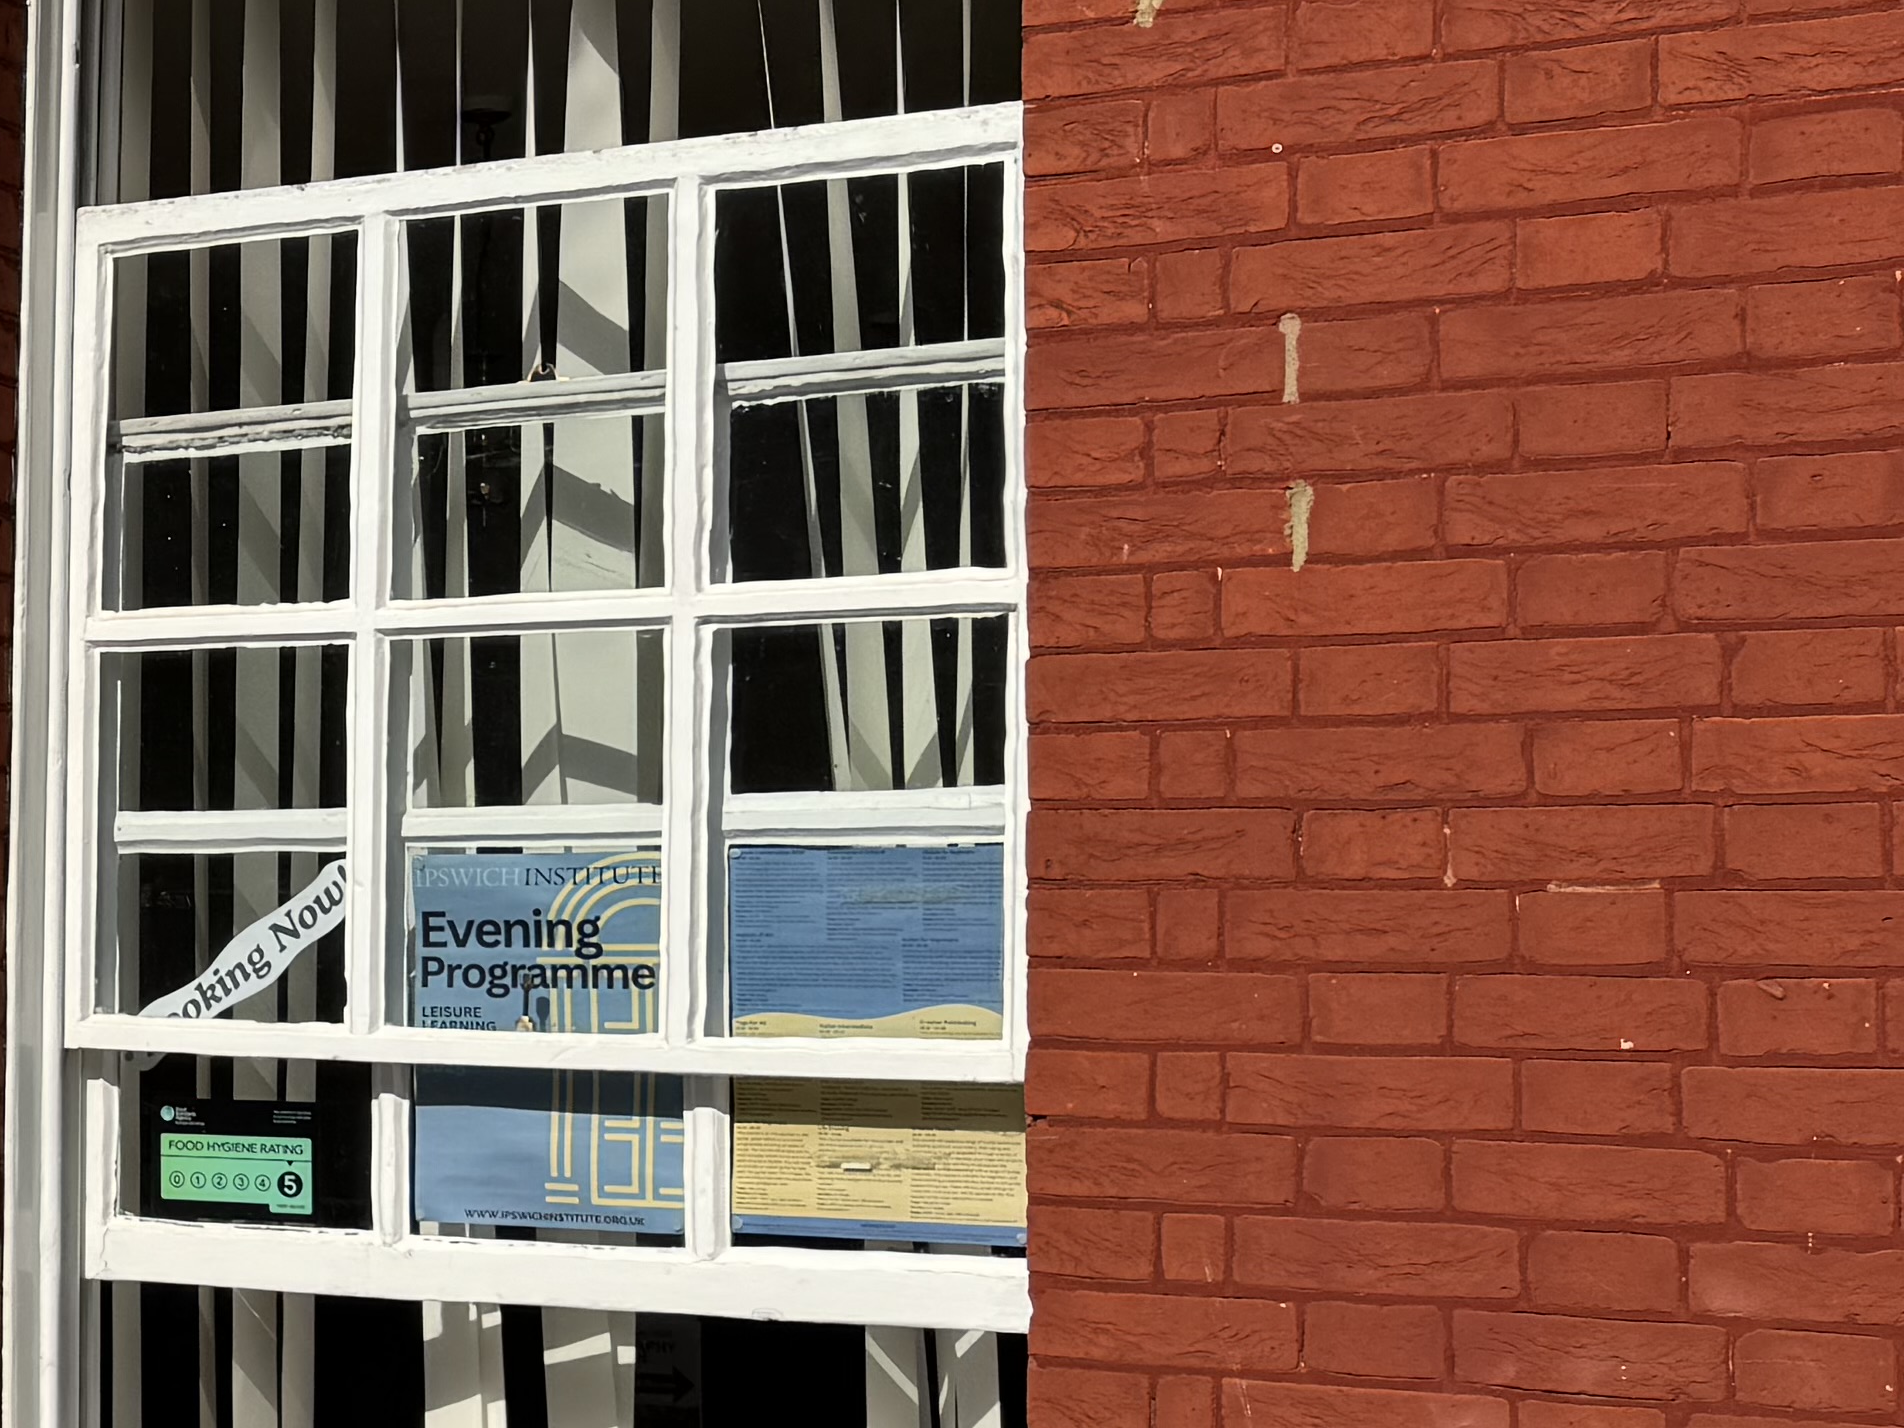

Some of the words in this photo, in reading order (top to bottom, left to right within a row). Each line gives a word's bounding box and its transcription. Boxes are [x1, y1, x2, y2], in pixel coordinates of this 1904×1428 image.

[415, 867, 521, 888] IPSWICH
[421, 908, 604, 960] Evening
[421, 956, 657, 999] Programme
[422, 1006, 482, 1019] LEISURE
[422, 1020, 497, 1031] LEARNING
[168, 1140, 204, 1152] FOOD
[207, 1141, 257, 1154] HYGIENE
[260, 1143, 304, 1155] RATING
[283, 1174, 298, 1196] 5
